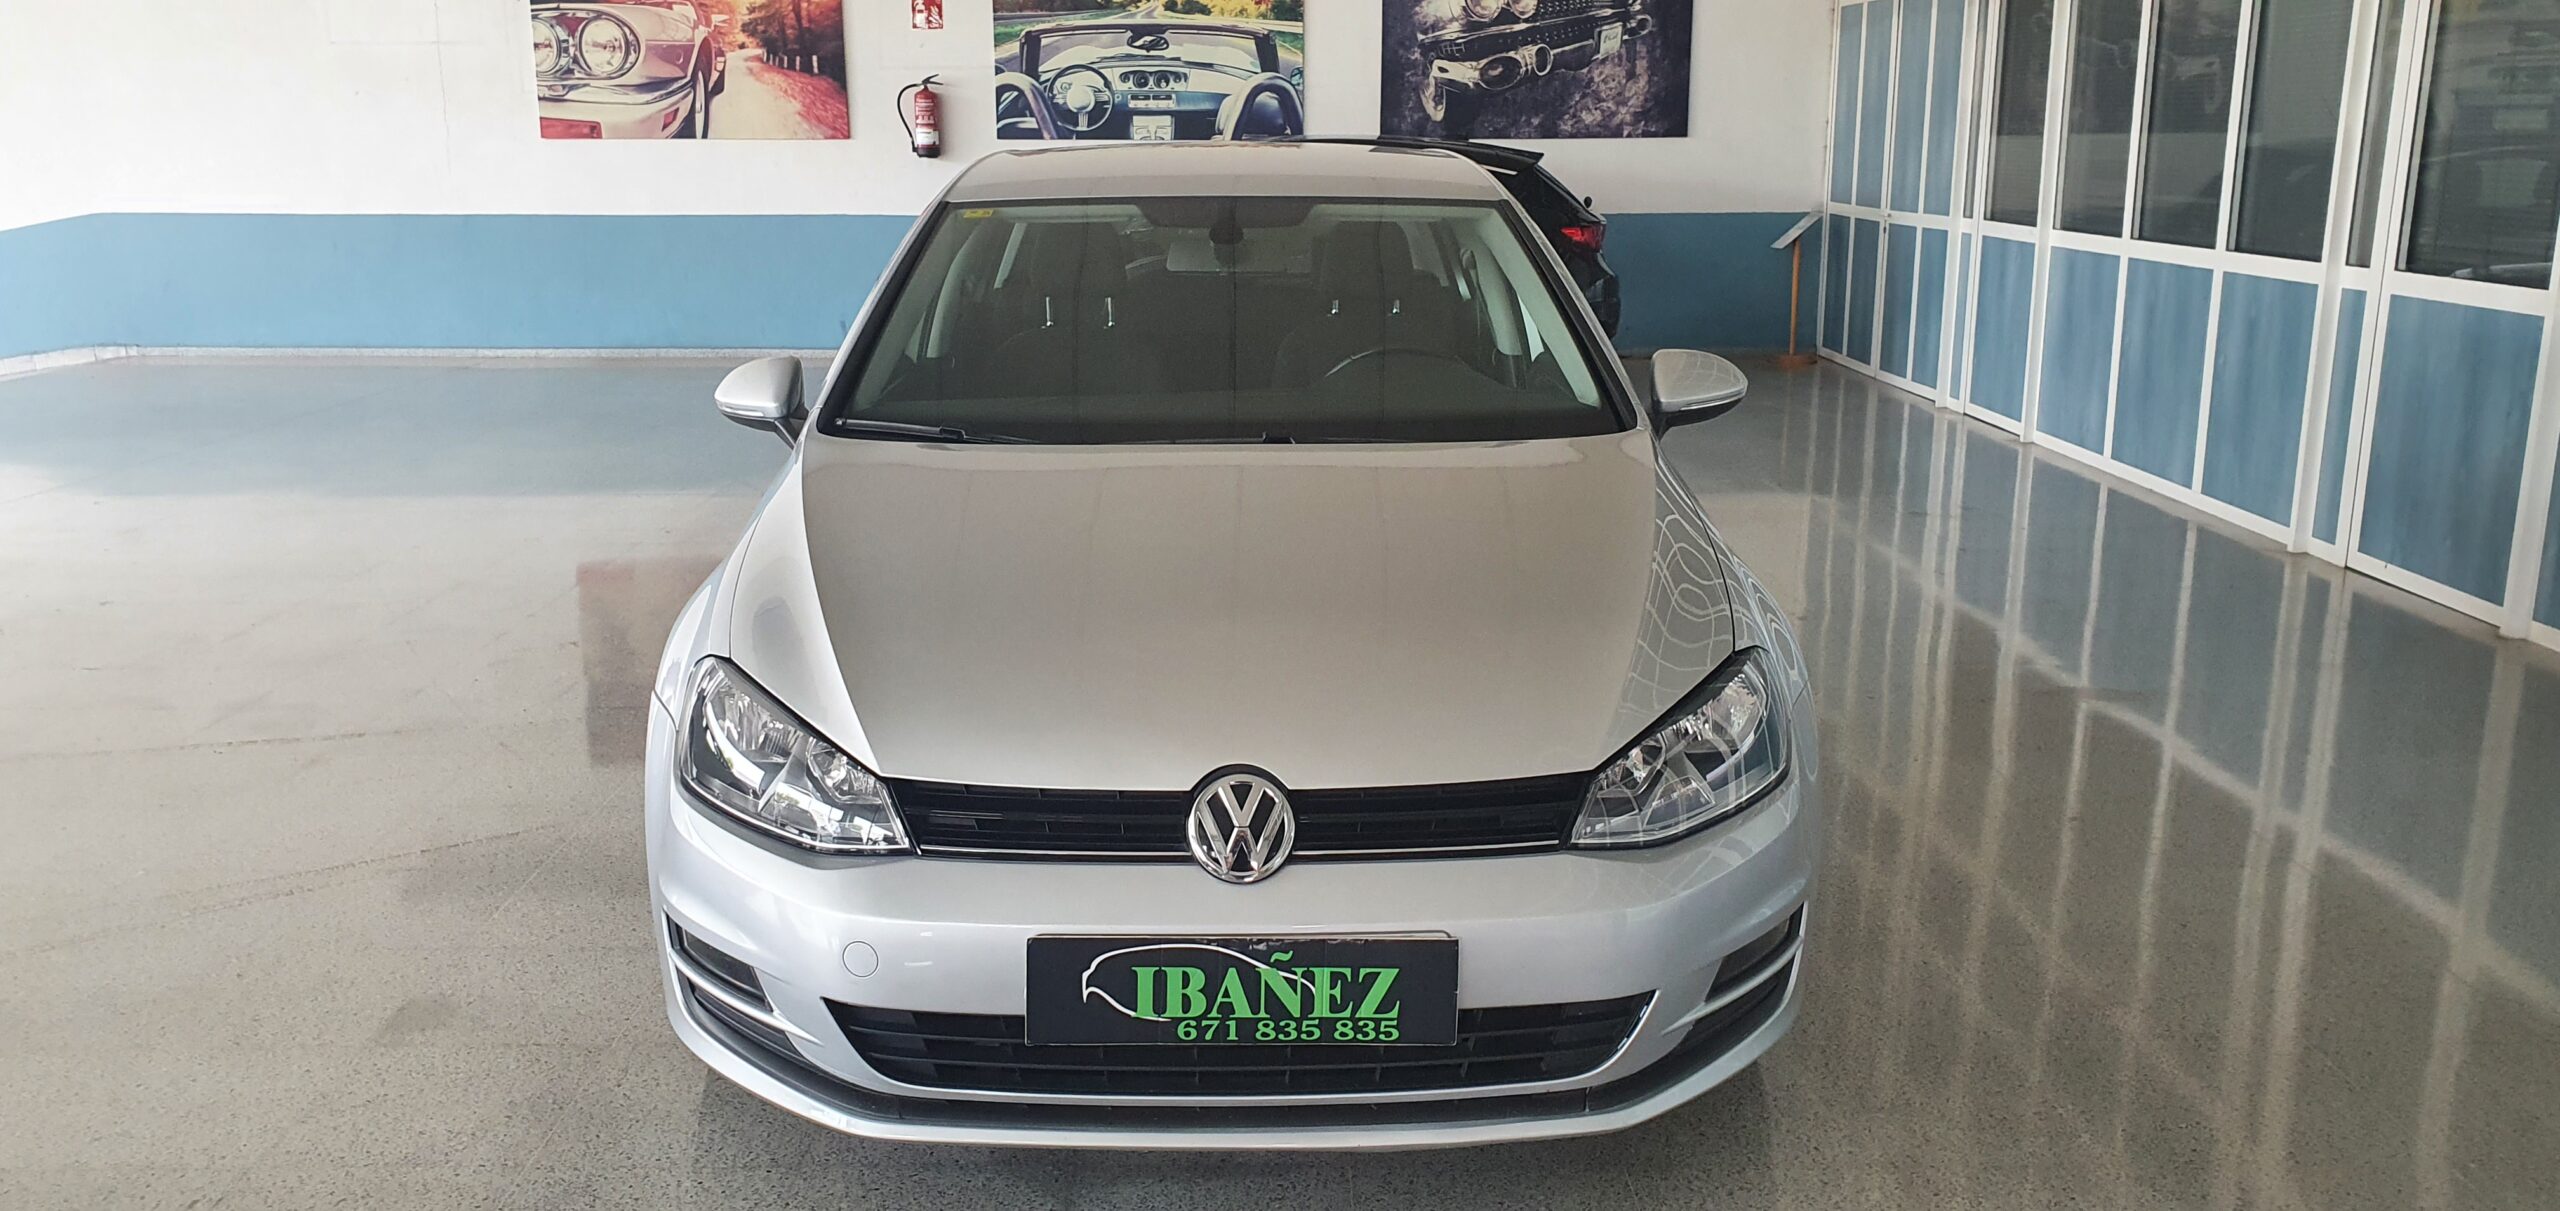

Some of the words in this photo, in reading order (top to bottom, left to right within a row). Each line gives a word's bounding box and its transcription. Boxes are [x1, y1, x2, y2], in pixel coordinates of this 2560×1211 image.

[1131, 949, 1401, 1019] IBAÑEZ
[1176, 1018, 1240, 1041] 671
[1254, 1018, 1322, 1041] 835
[1332, 1018, 1401, 1041] 835
